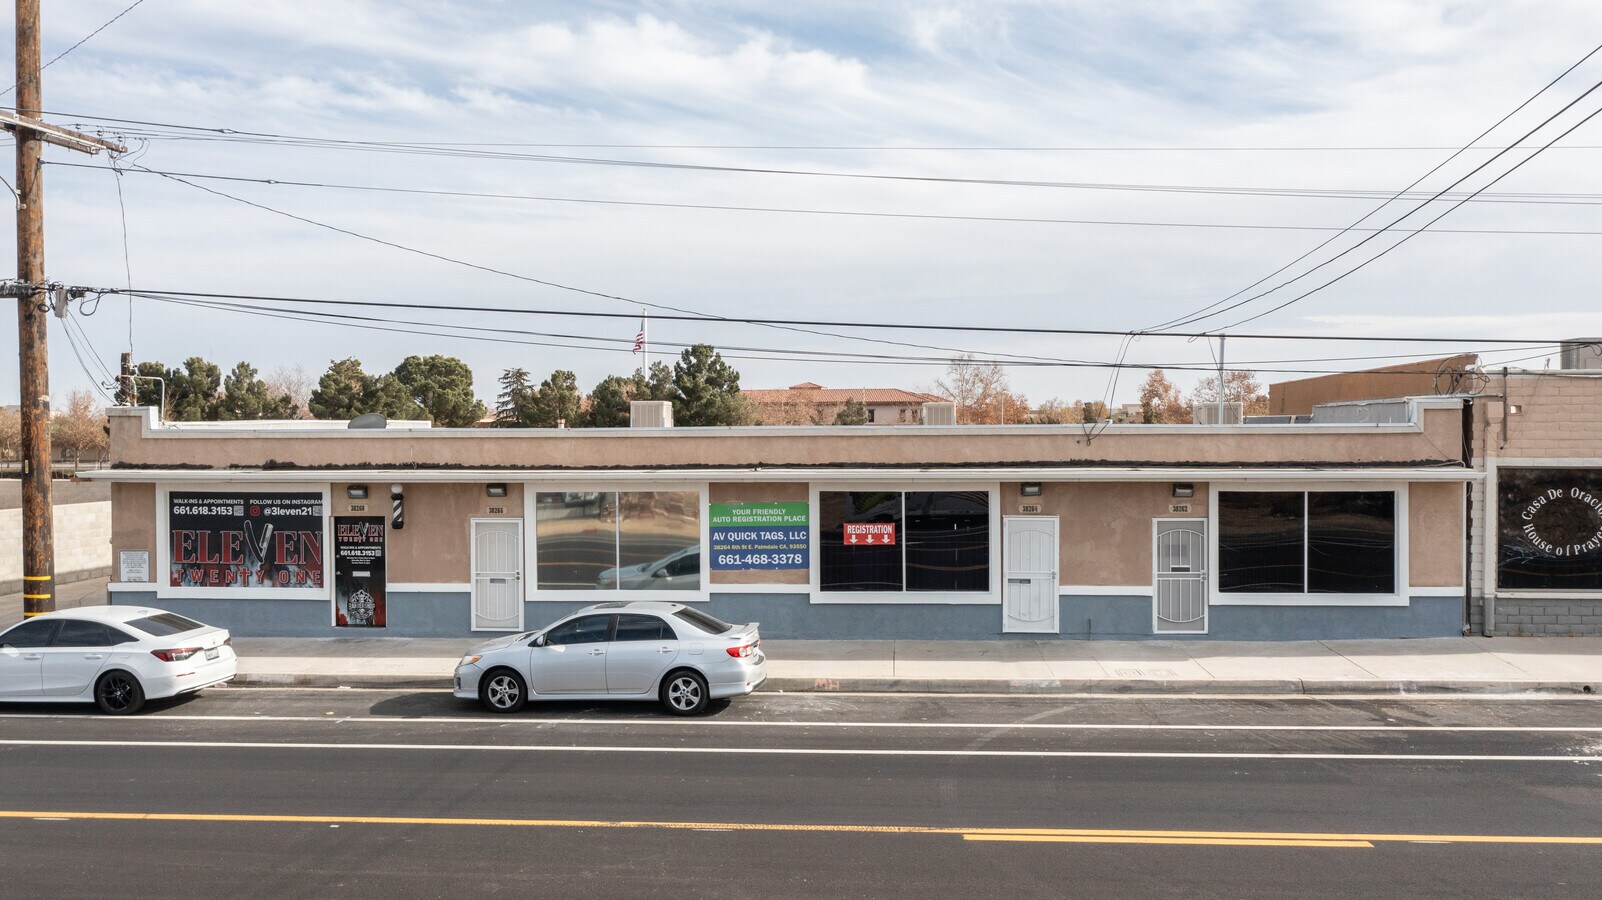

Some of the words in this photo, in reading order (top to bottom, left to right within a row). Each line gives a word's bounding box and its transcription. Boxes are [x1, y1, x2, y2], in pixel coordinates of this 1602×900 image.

[1022, 505, 1038, 513] 38264
[1521, 495, 1547, 520] Casa
[1547, 488, 1563, 500] De
[1570, 487, 1602, 518] Oracio
[173, 506, 233, 515] 661.618.3153
[263, 506, 312, 516] @3leven21
[732, 515, 782, 523] REGISTRATION
[337, 522, 384, 537] ELEVEN
[847, 525, 892, 534] REGISTRATION
[713, 532, 726, 540] AV
[727, 532, 757, 542] QUICK
[760, 531, 787, 541] TAGS,
[789, 531, 807, 540] LLC
[1522, 523, 1553, 553] House
[1555, 544, 1571, 556] of
[1573, 526, 1602, 555] Praye
[172, 520, 323, 565] ELEVEN
[718, 554, 803, 565] 661-468-3378
[175, 567, 266, 587] TWENTY
[278, 569, 321, 584] ONE
